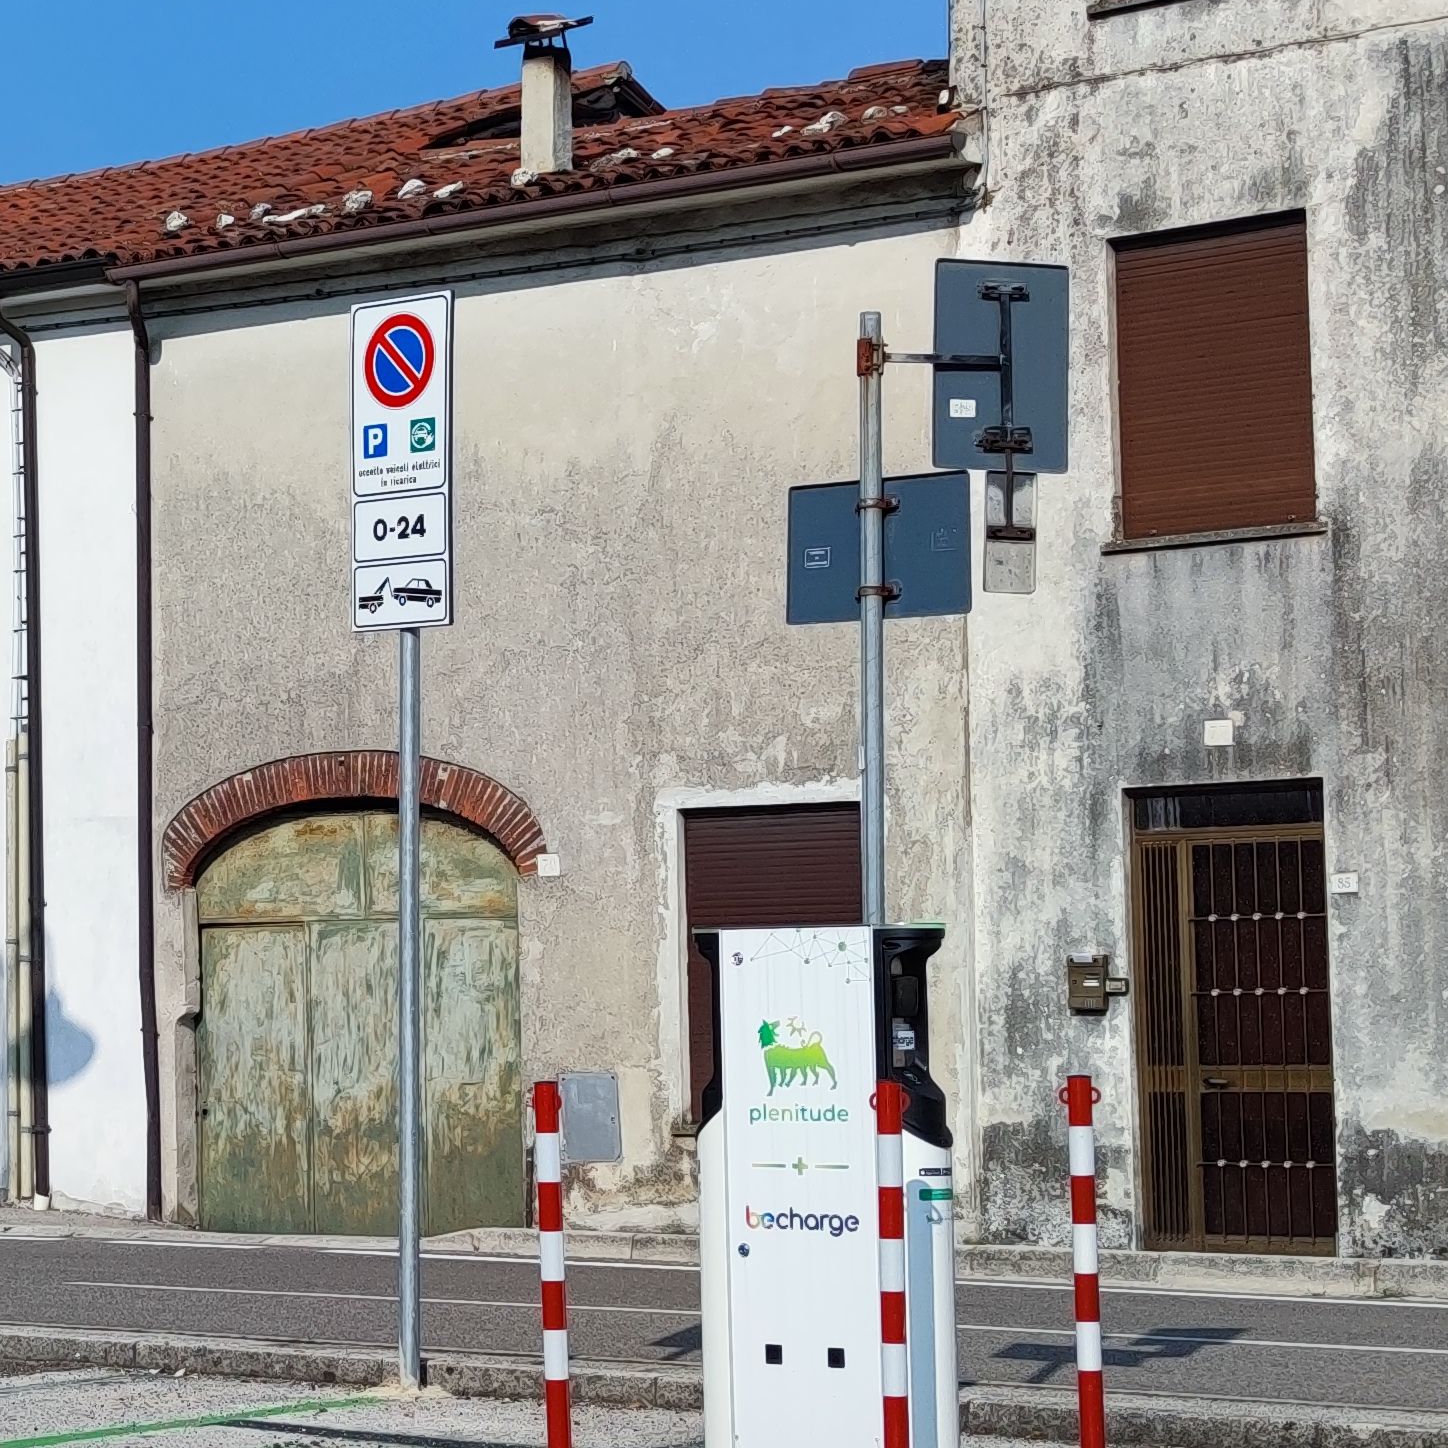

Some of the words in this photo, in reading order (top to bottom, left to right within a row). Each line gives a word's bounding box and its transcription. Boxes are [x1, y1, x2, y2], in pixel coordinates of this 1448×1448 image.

[368, 428, 383, 456] P
[372, 513, 427, 542] 0-24
[749, 1103, 849, 1125] plenitude
[745, 1204, 860, 1238] becharge
